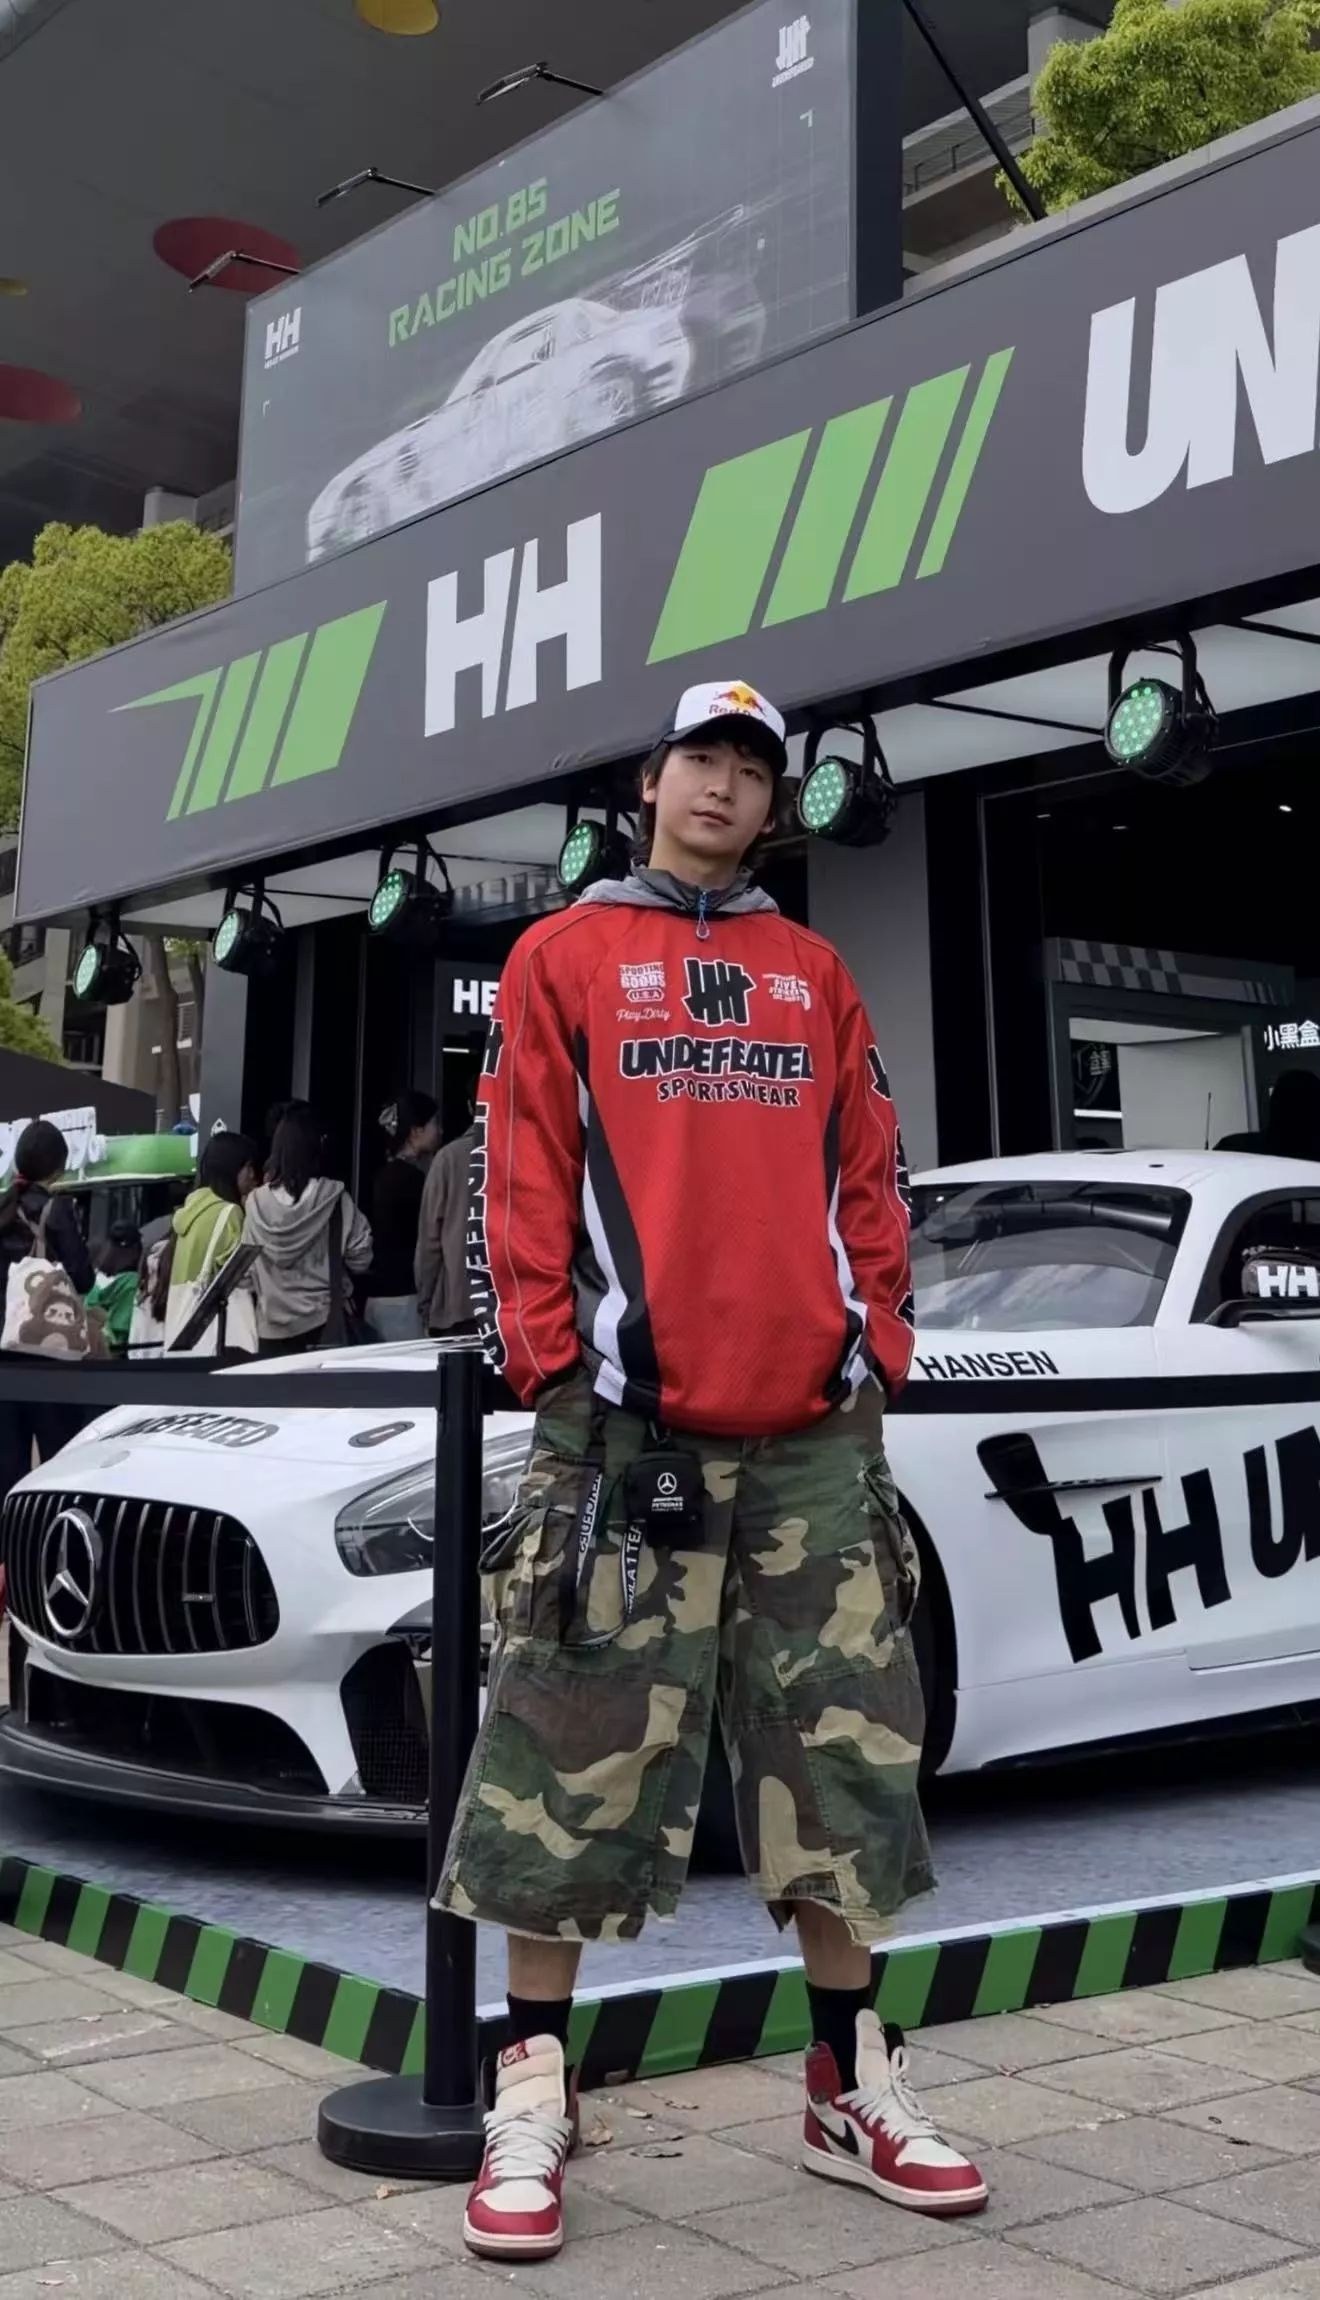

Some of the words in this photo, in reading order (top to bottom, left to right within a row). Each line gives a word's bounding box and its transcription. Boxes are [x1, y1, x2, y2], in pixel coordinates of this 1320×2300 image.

[453, 177, 548, 263] NO.85
[388, 248, 512, 348] RACING
[521, 188, 621, 276] ZONE
[264, 306, 302, 360] HH
[424, 512, 602, 738] HH
[1263, 1019, 1320, 1051] 小黑盒
[657, 1076, 800, 1108] SPORTSWEAR
[1256, 1265, 1320, 1298] HH
[914, 1350, 1060, 1381] HANSEN
[1048, 1467, 1232, 1664] HH
